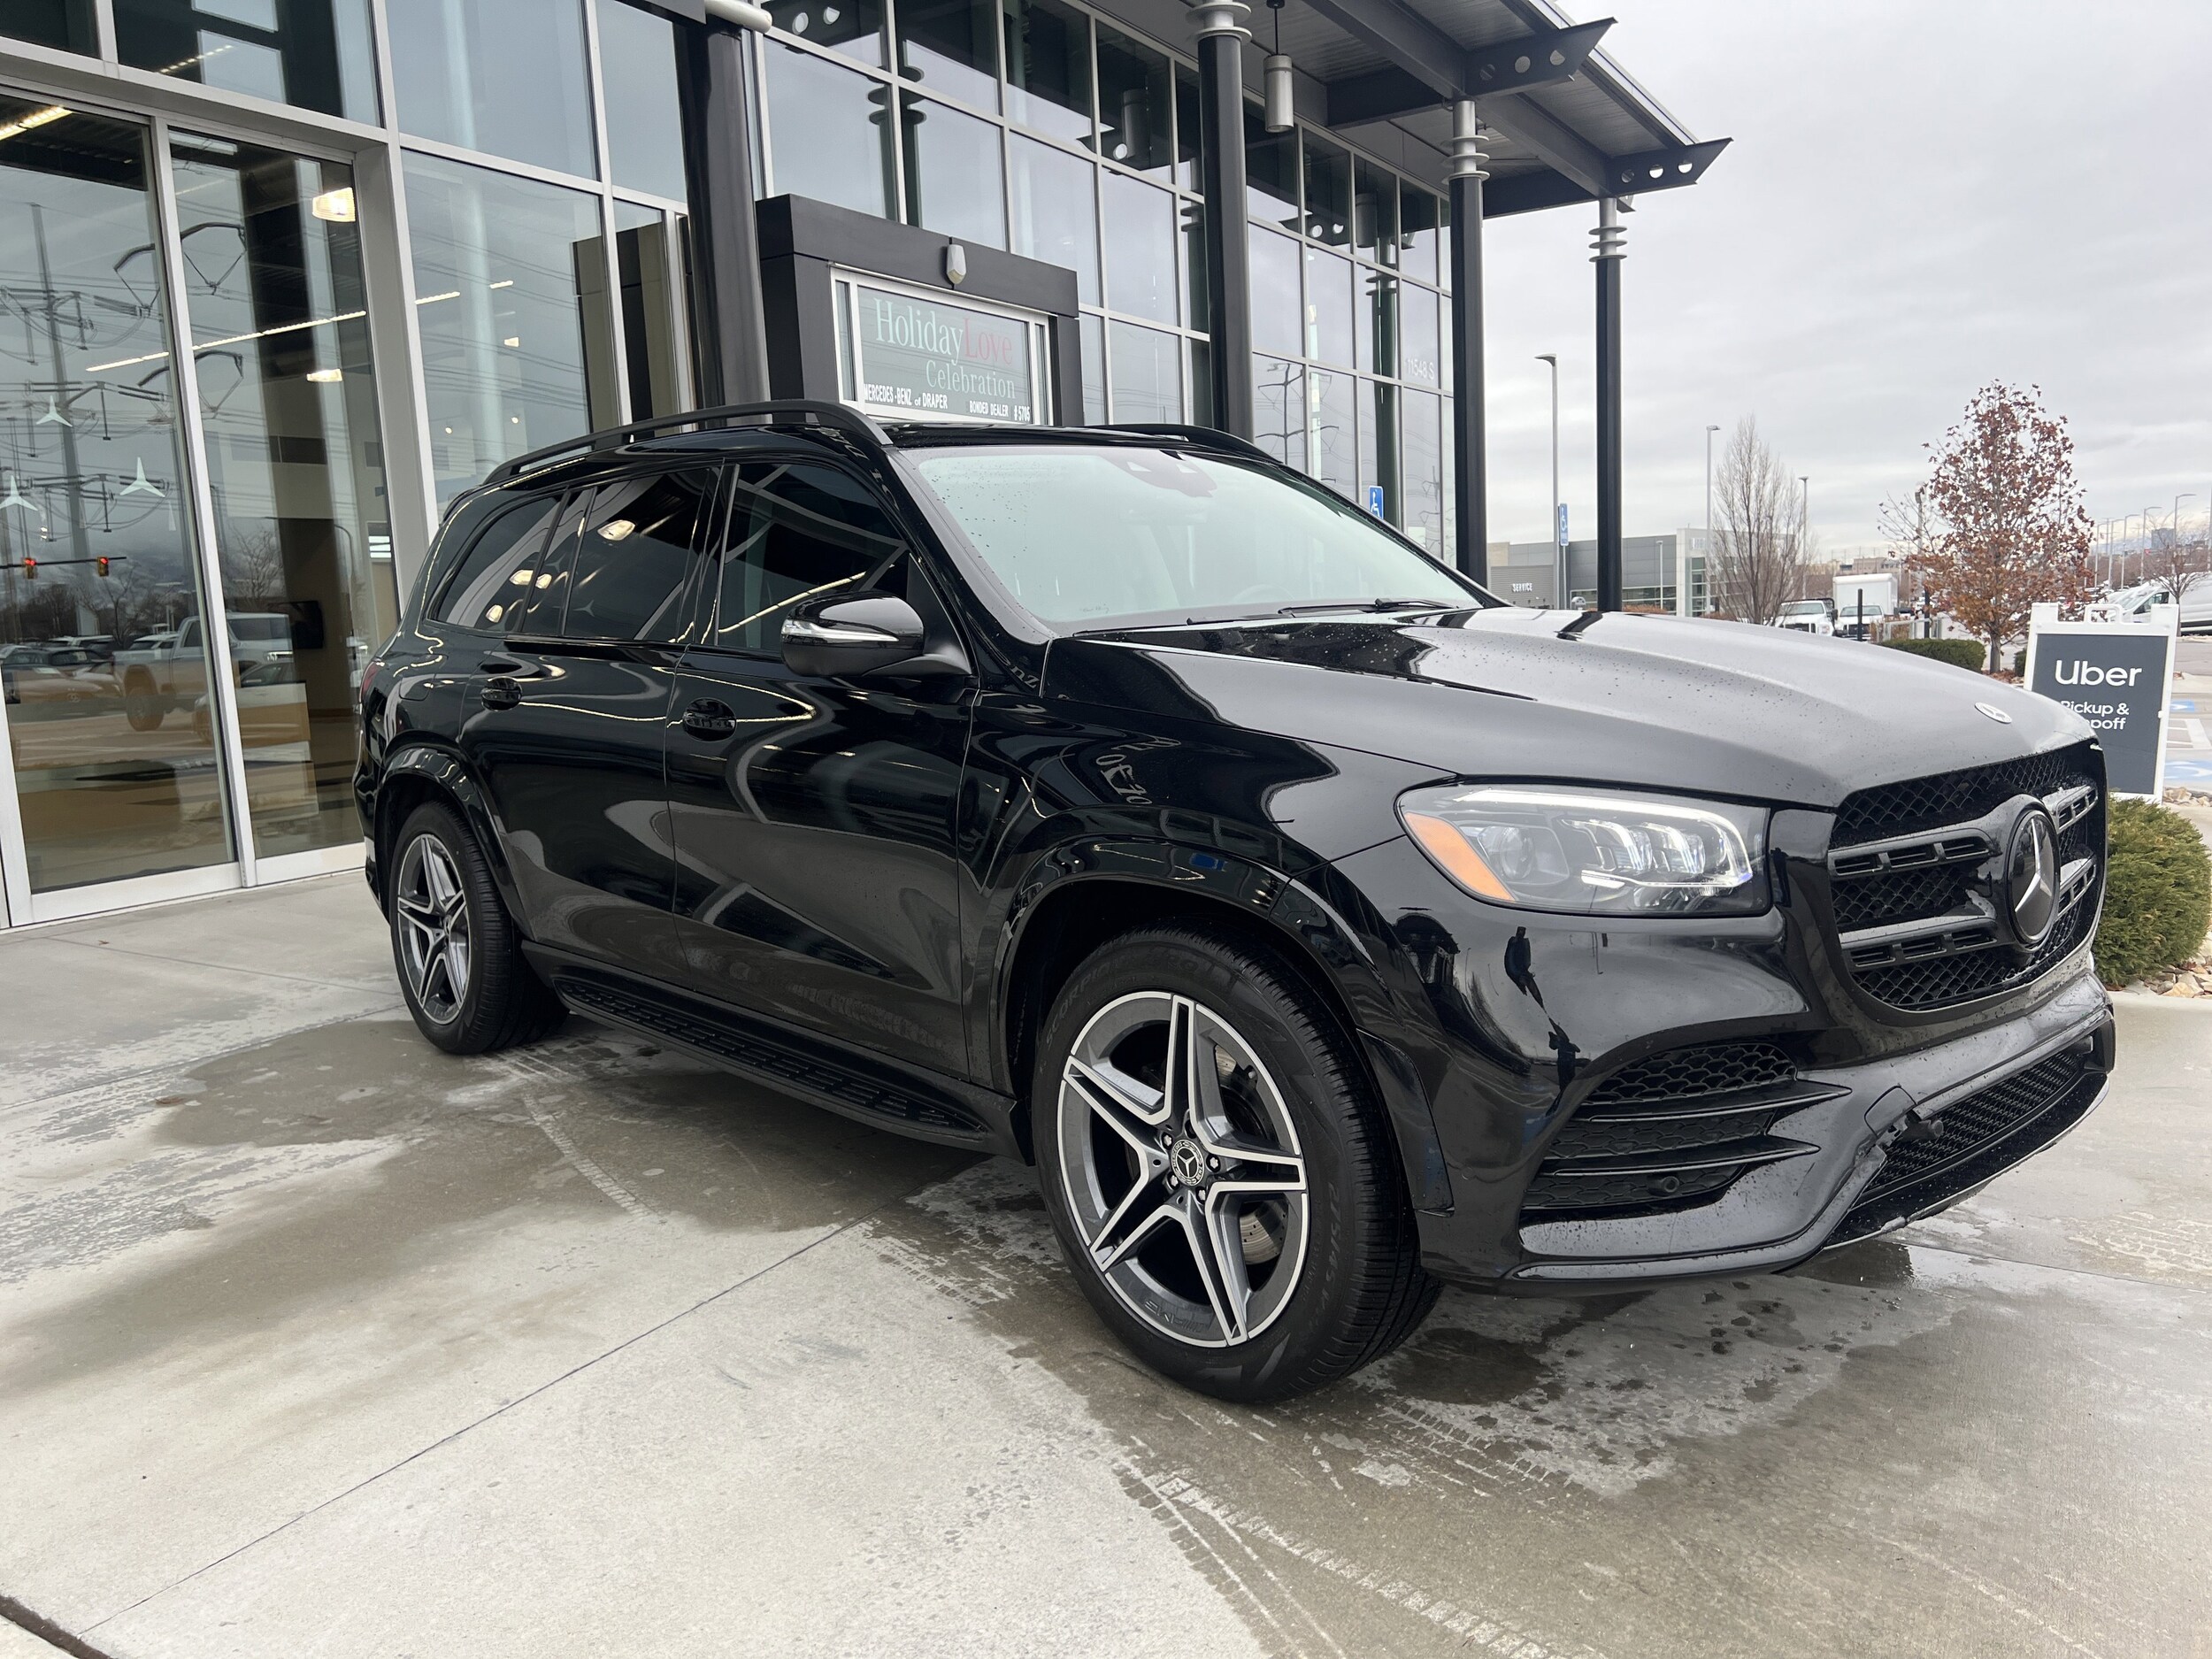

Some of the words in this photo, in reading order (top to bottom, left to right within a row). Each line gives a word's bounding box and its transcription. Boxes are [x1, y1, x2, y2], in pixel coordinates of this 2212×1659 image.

[872, 297, 964, 366] Holiday
[963, 317, 1014, 365] Love
[926, 359, 1016, 399] Celebration
[914, 396, 921, 406] of
[922, 392, 949, 410] DRAPER
[969, 400, 989, 415] BONDED
[990, 403, 1009, 417] DEALER
[1512, 582, 1532, 592] SERVICE
[2055, 659, 2142, 687] Uber
[2060, 700, 2114, 718] Pickup
[2116, 703, 2130, 716] &
[2085, 717, 2127, 730] poff
